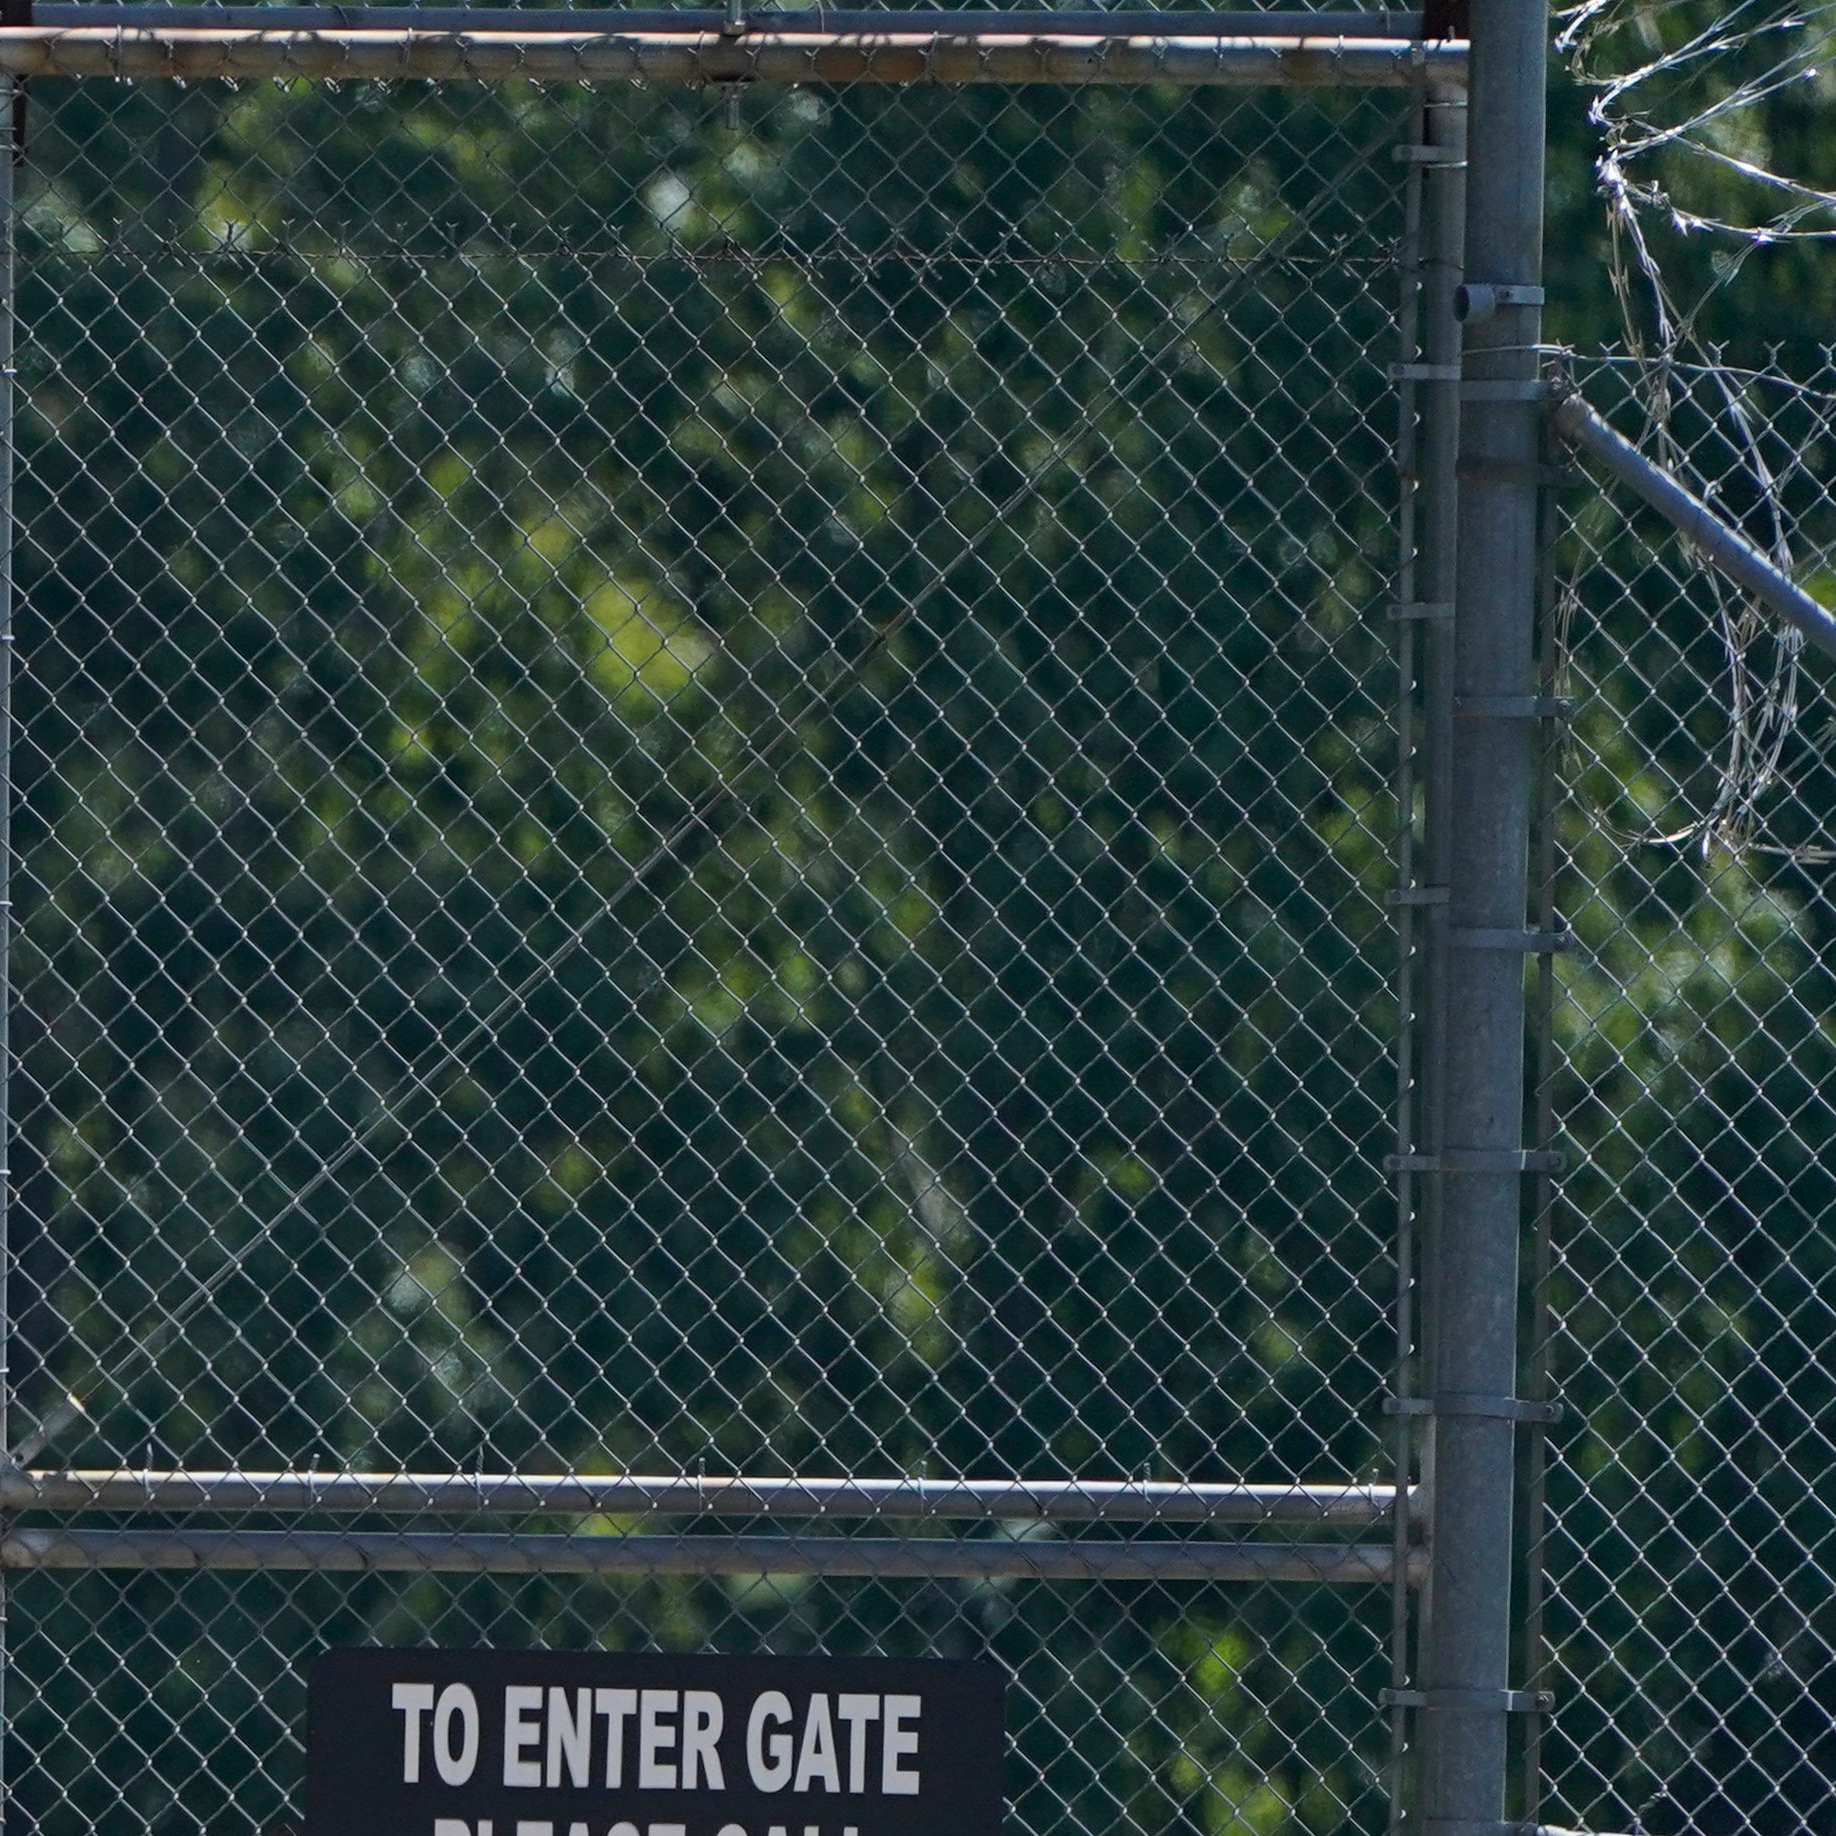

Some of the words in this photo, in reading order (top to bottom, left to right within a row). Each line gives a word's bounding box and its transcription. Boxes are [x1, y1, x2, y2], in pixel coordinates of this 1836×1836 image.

[391, 1682, 480, 1786] TO
[503, 1685, 726, 1790] ENTER
[746, 1690, 922, 1795] GATE
